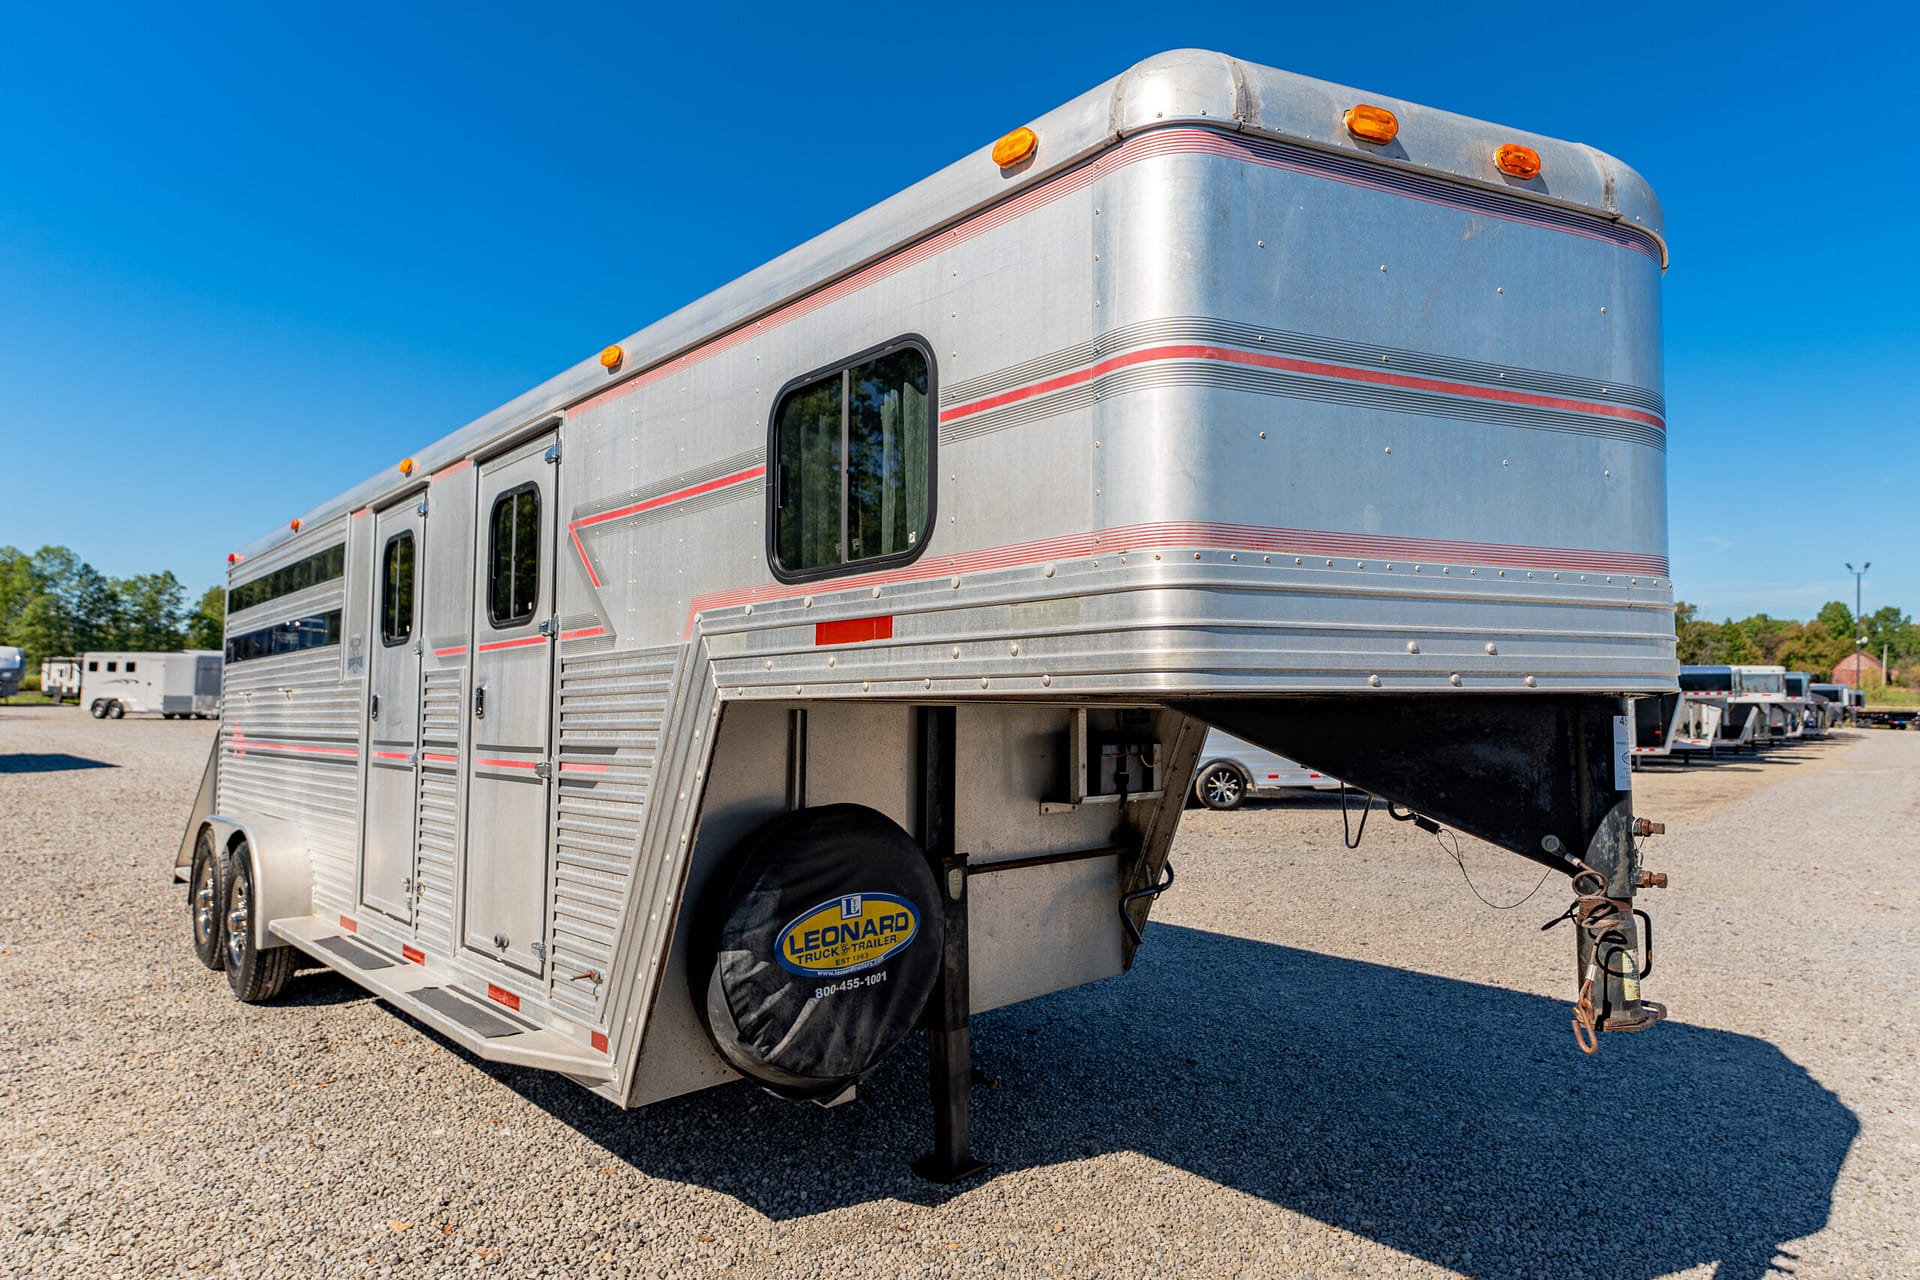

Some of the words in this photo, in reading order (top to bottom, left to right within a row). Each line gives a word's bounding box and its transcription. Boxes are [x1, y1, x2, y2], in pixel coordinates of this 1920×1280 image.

[789, 911, 909, 956] LEONARD
[796, 946, 840, 965] TRUCK
[851, 934, 897, 953] TRAILER
[815, 970, 887, 999] 800-455-1001
